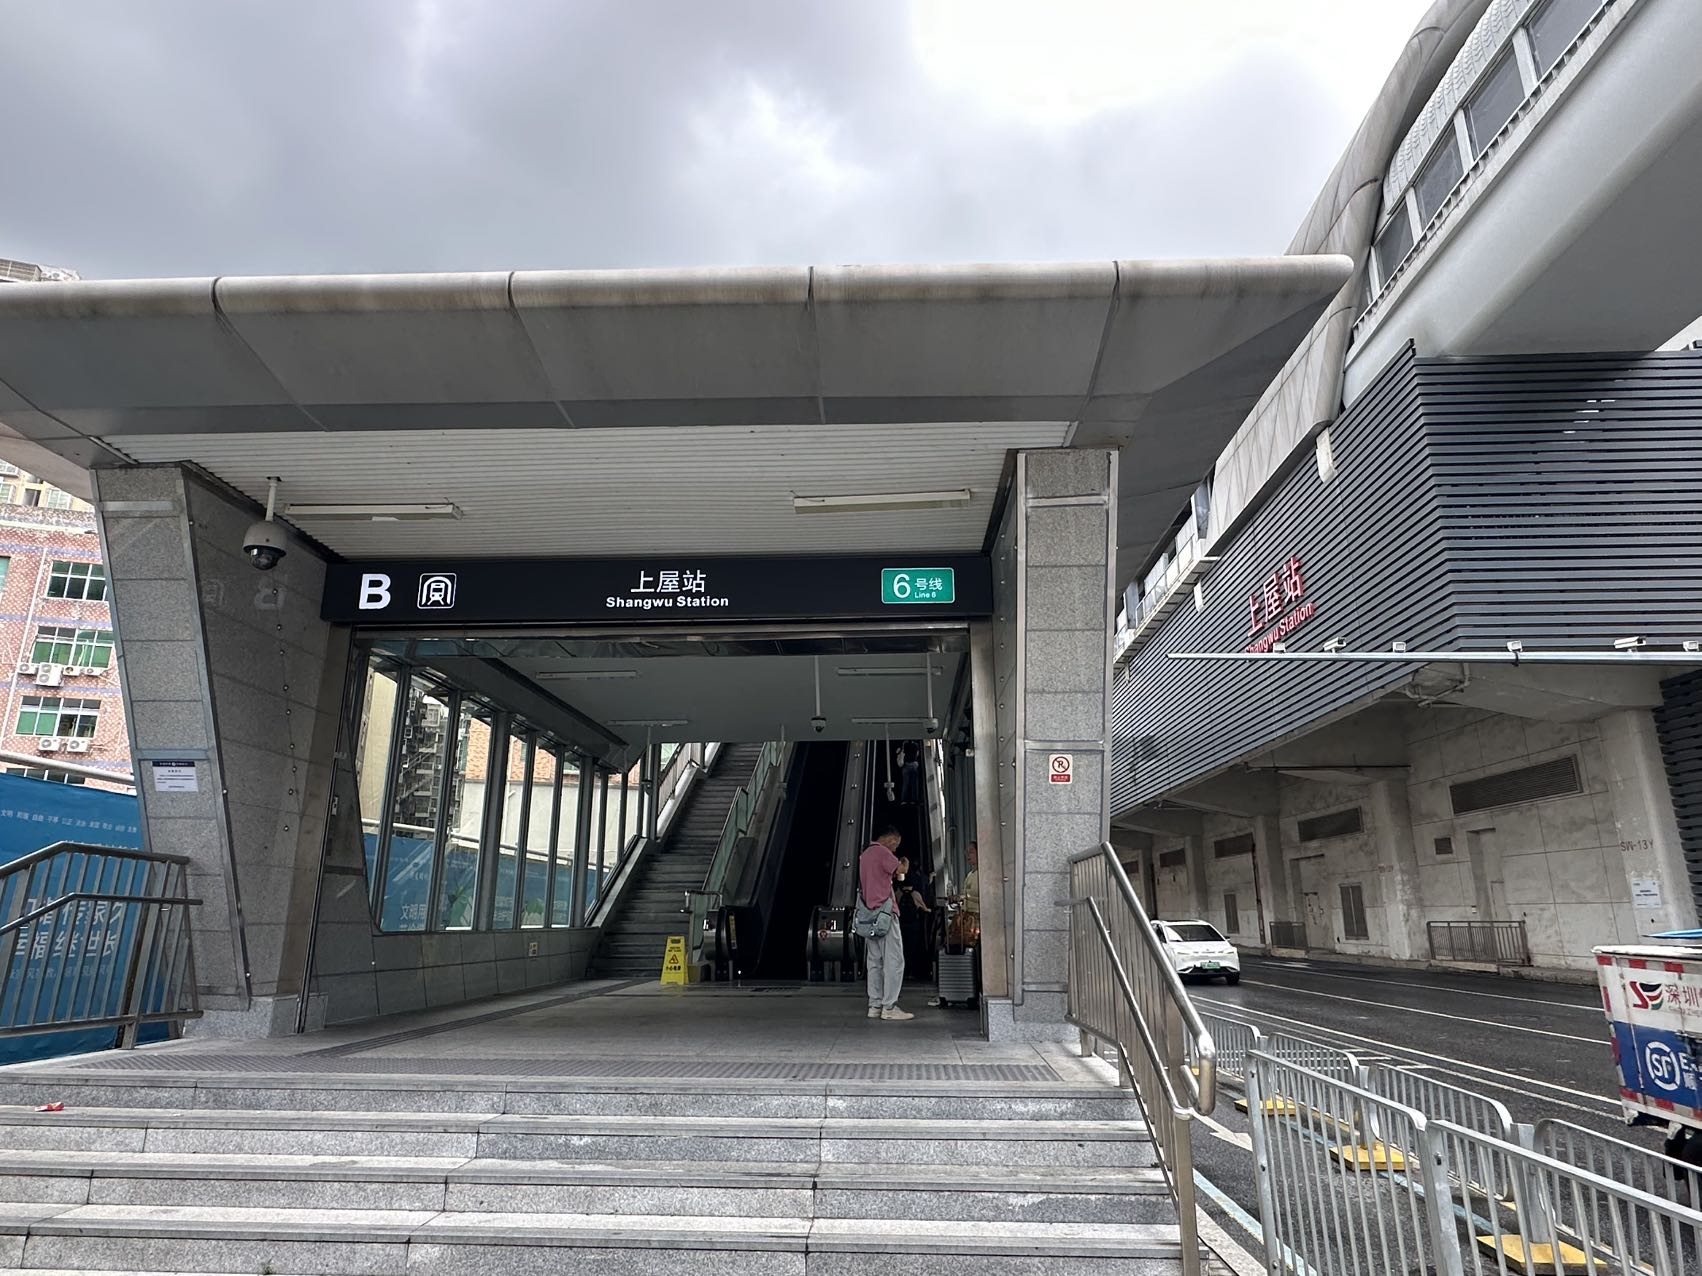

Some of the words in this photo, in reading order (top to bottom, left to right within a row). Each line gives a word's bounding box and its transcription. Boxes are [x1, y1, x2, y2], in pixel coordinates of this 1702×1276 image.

[359, 573, 391, 610] B
[630, 569, 707, 593] 上屋站
[893, 573, 911, 598] 6
[915, 577, 942, 591] 号线
[606, 596, 673, 610] Shangwu
[676, 595, 729, 607] Station
[914, 591, 930, 599] Line
[1248, 555, 1304, 637] 上屋站
[1280, 602, 1316, 636] Station
[1665, 983, 1702, 1008] 深圳
